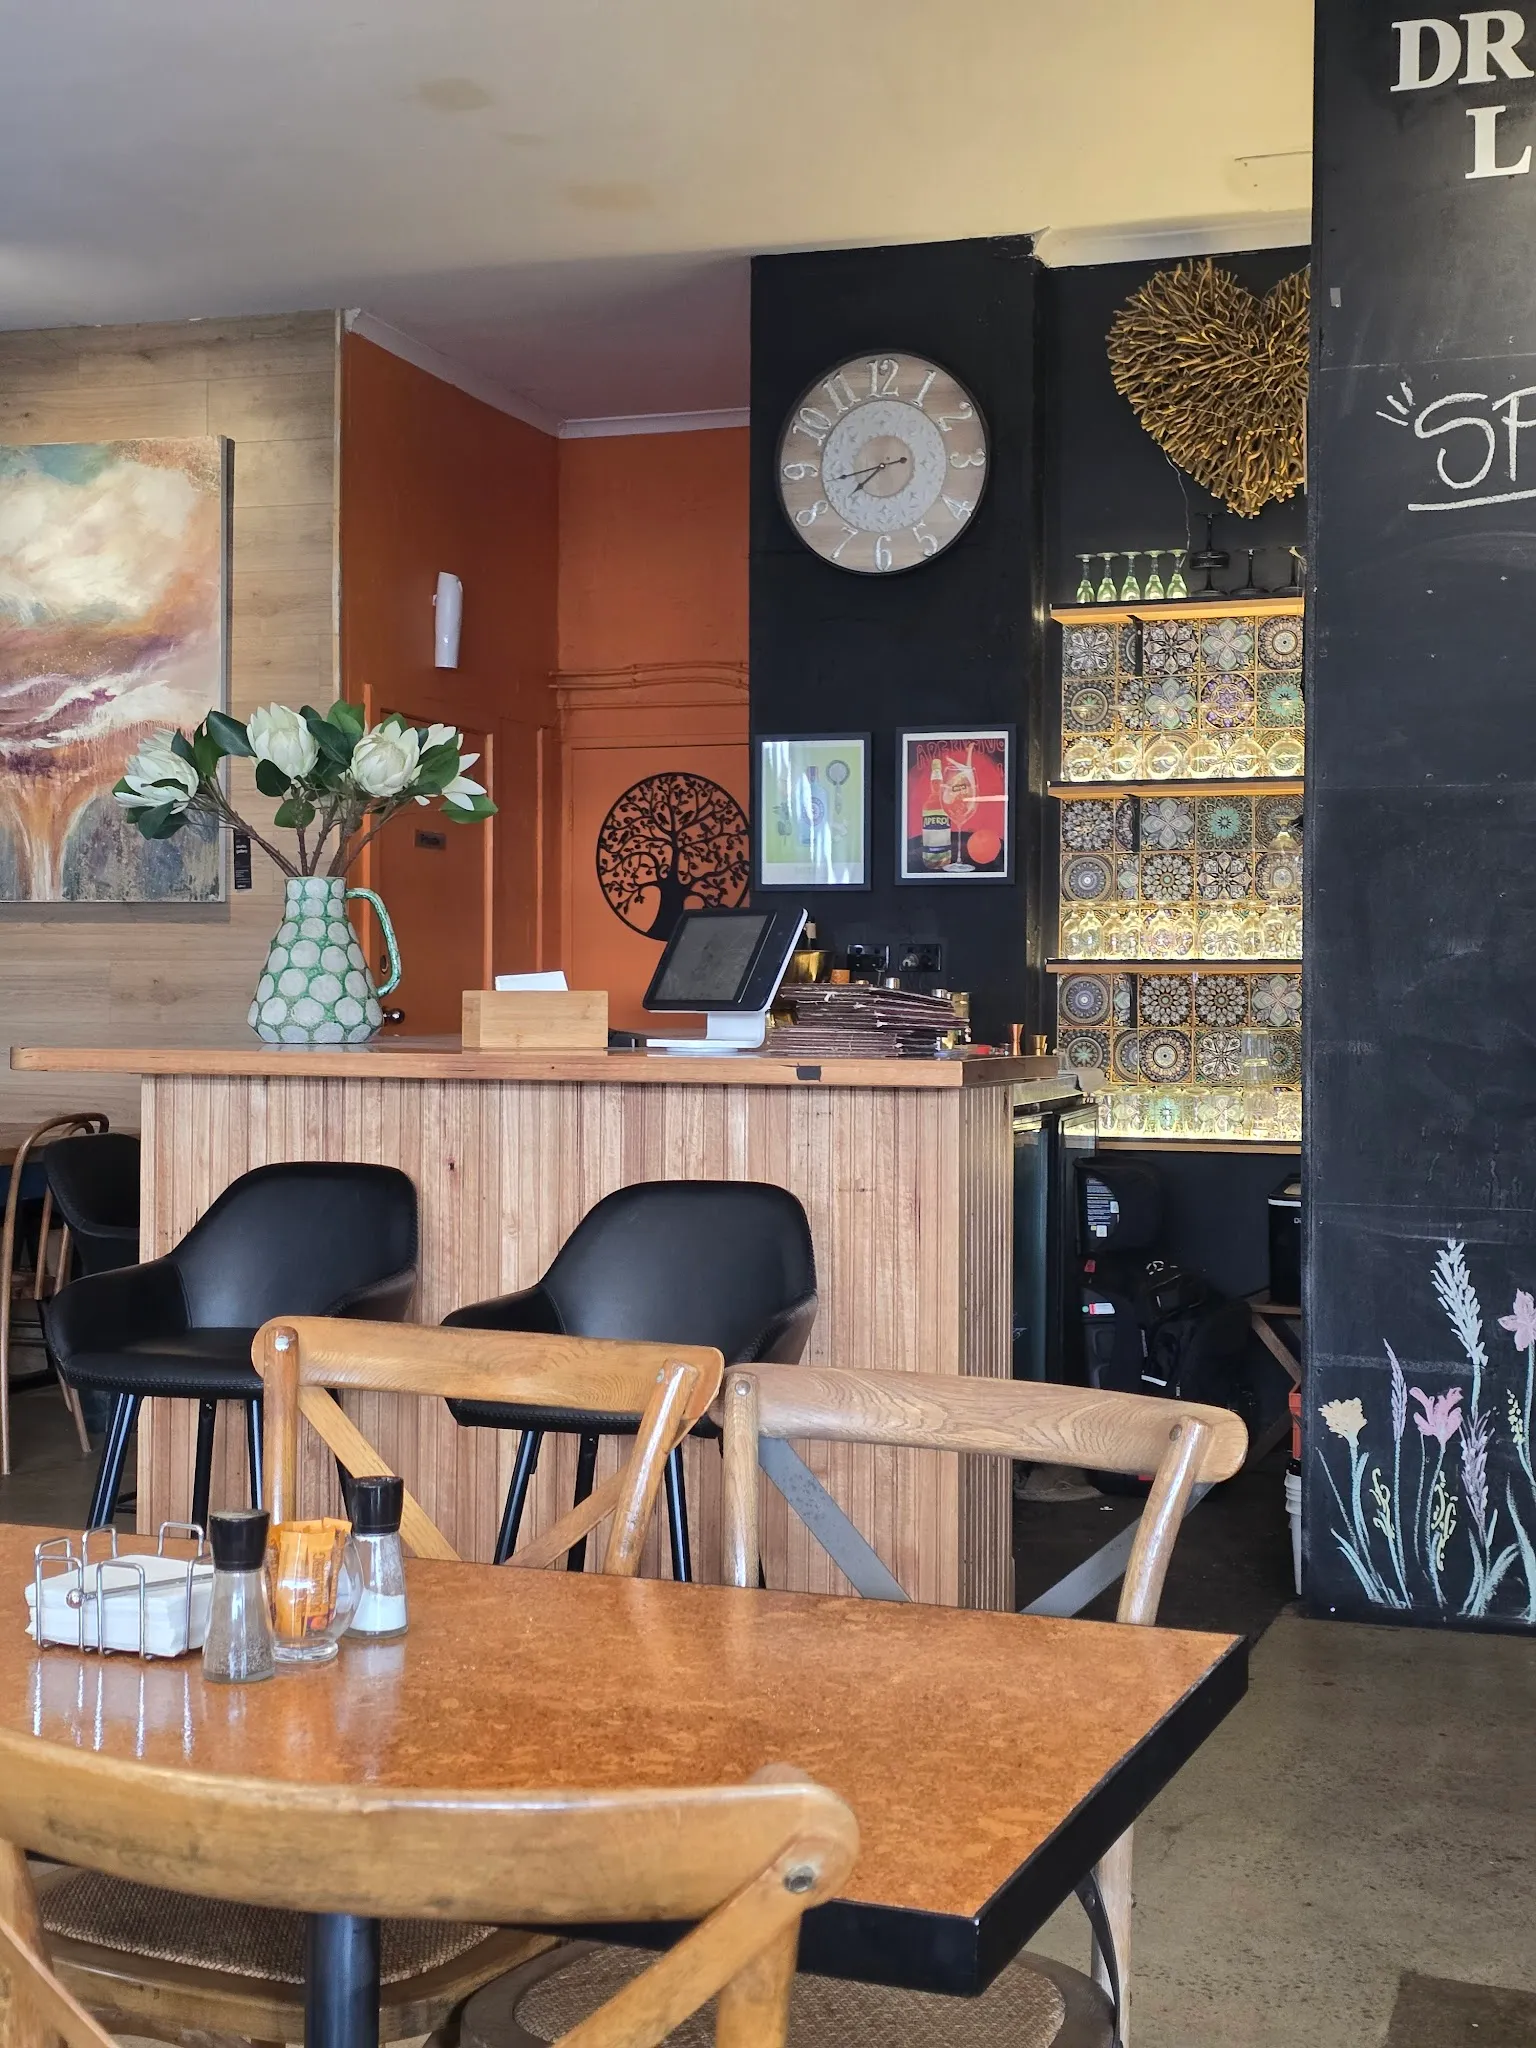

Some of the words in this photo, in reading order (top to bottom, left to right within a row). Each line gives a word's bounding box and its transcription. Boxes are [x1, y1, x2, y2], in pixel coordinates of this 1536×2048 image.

[1390, 10, 1535, 92] DR
[1465, 105, 1532, 180] L
[822, 371, 861, 416] 11
[867, 359, 899, 398] 12
[912, 369, 937, 407] 1
[793, 407, 832, 446] 10
[937, 401, 973, 432] 2
[783, 463, 819, 481] 9
[950, 448, 986, 469] 3
[796, 500, 829, 527] 8
[941, 494, 972, 520] 4
[832, 523, 858, 559] 7
[875, 535, 892, 571] 6
[912, 520, 938, 557] 5
